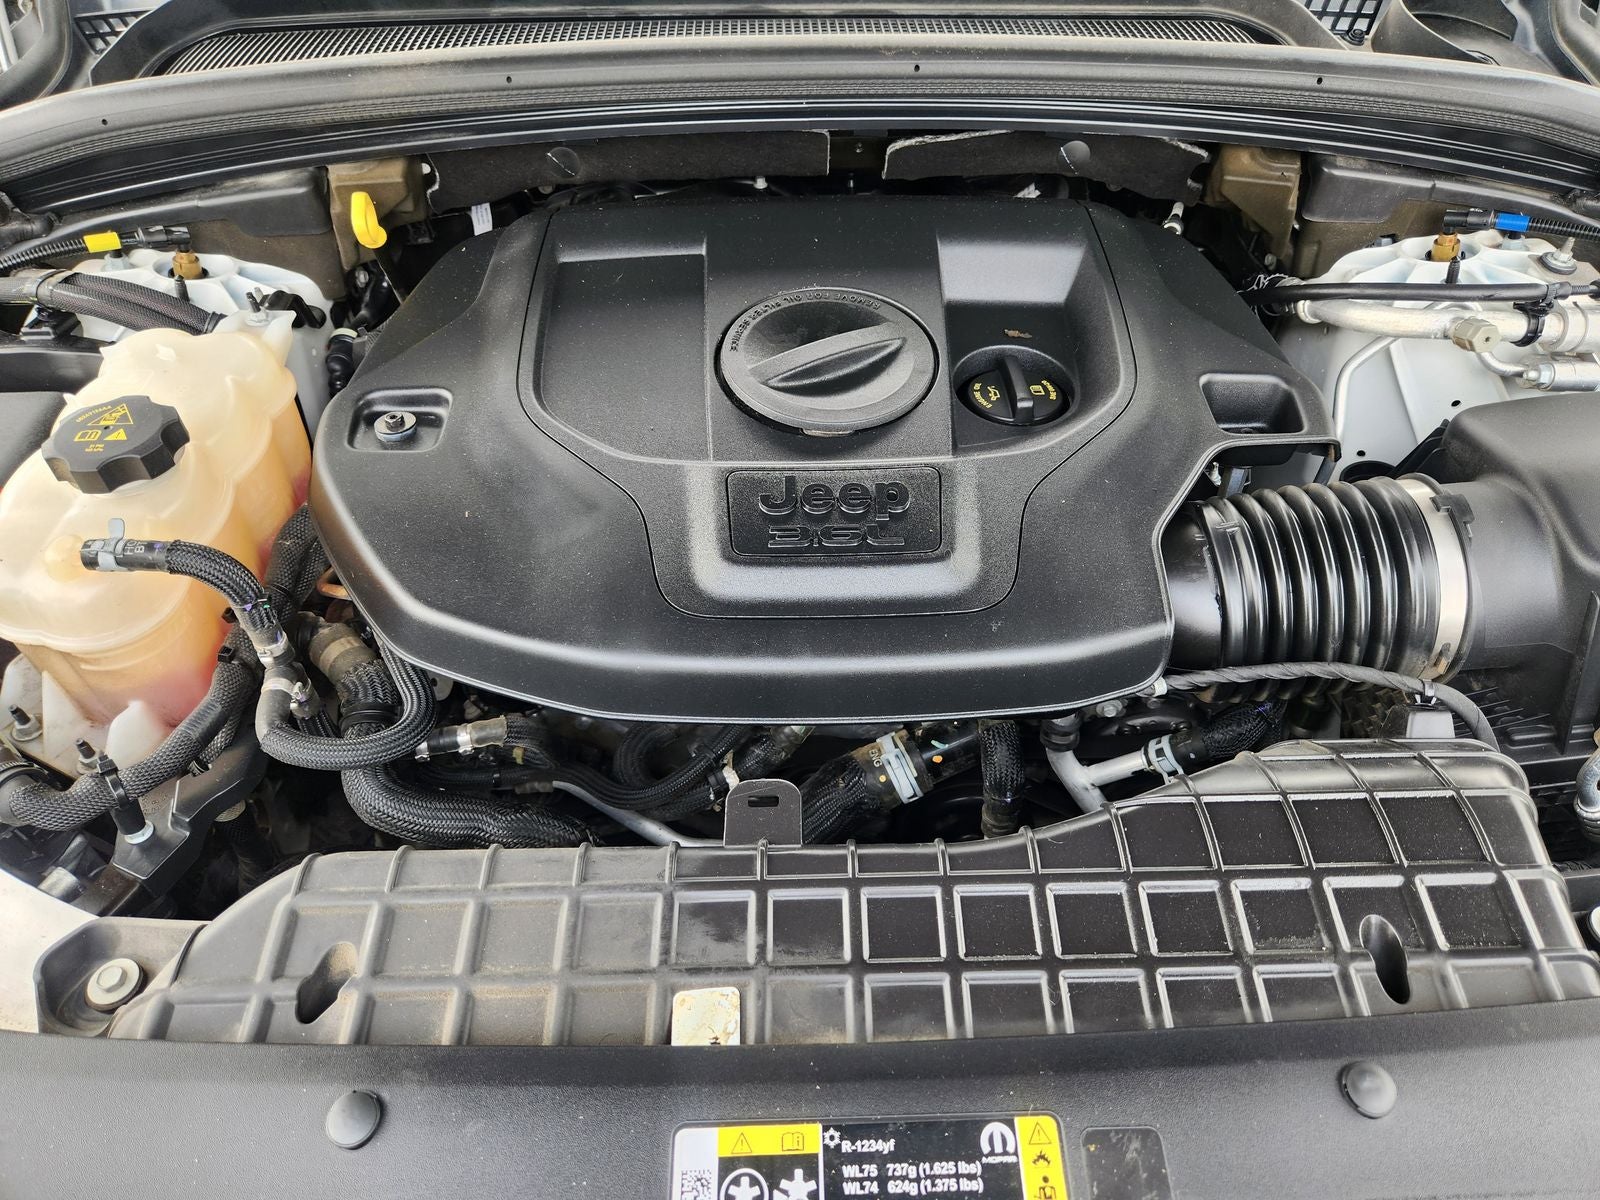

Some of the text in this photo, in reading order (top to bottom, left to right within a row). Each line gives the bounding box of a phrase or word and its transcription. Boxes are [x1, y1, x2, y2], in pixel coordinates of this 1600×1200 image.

[783, 295, 803, 304] OIL
[806, 291, 830, 300] FOR
[833, 293, 881, 311] REMOVE
[750, 301, 782, 321] FILTER
[758, 475, 911, 521] Jeep
[768, 523, 905, 548] 3.6L
[841, 1139, 896, 1155] R-1234yf
[841, 1160, 982, 1179] WL75 737g (1.625 lbs)
[842, 1177, 984, 1197] WL74 624g (1.375 lbs)
